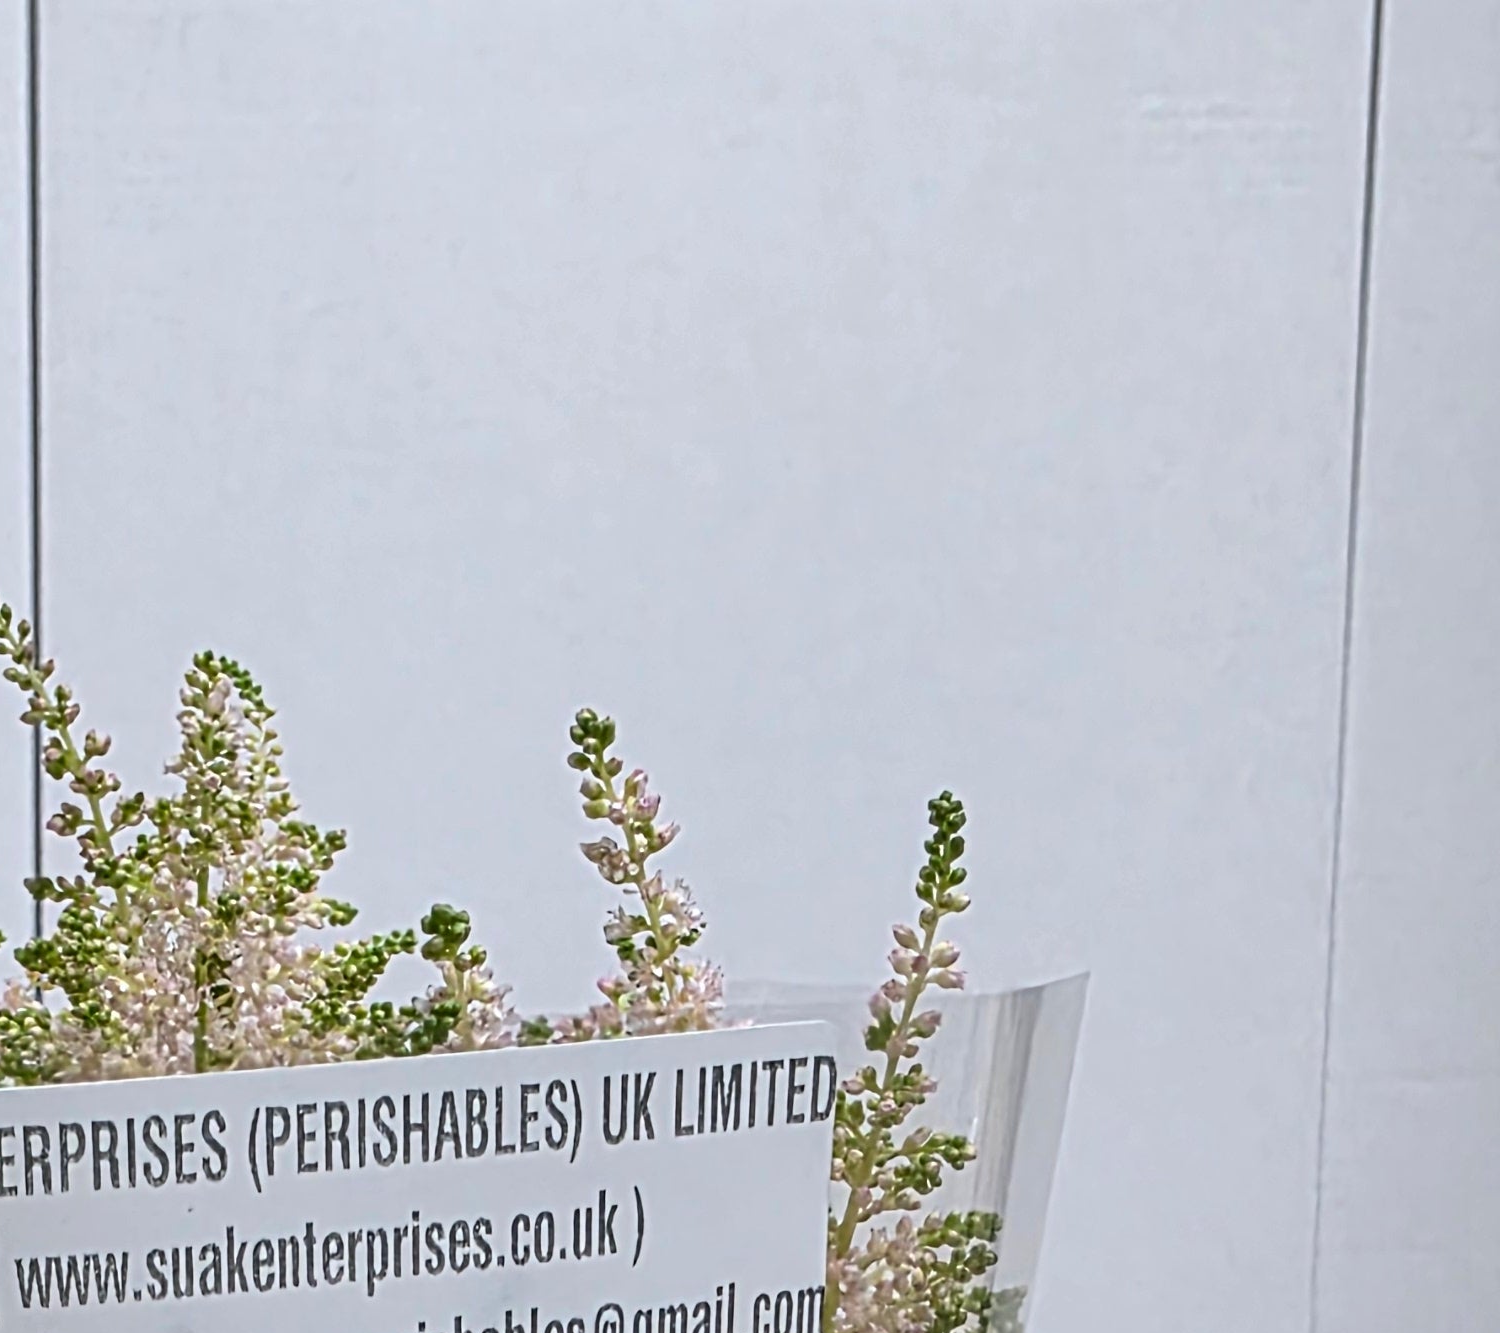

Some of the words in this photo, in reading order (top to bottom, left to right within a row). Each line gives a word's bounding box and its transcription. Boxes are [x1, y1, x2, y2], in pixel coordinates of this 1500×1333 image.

[249, 1080, 582, 1193] (PERISHABLES)
[603, 1072, 656, 1144] UK
[675, 1056, 837, 1136] LIMITED
